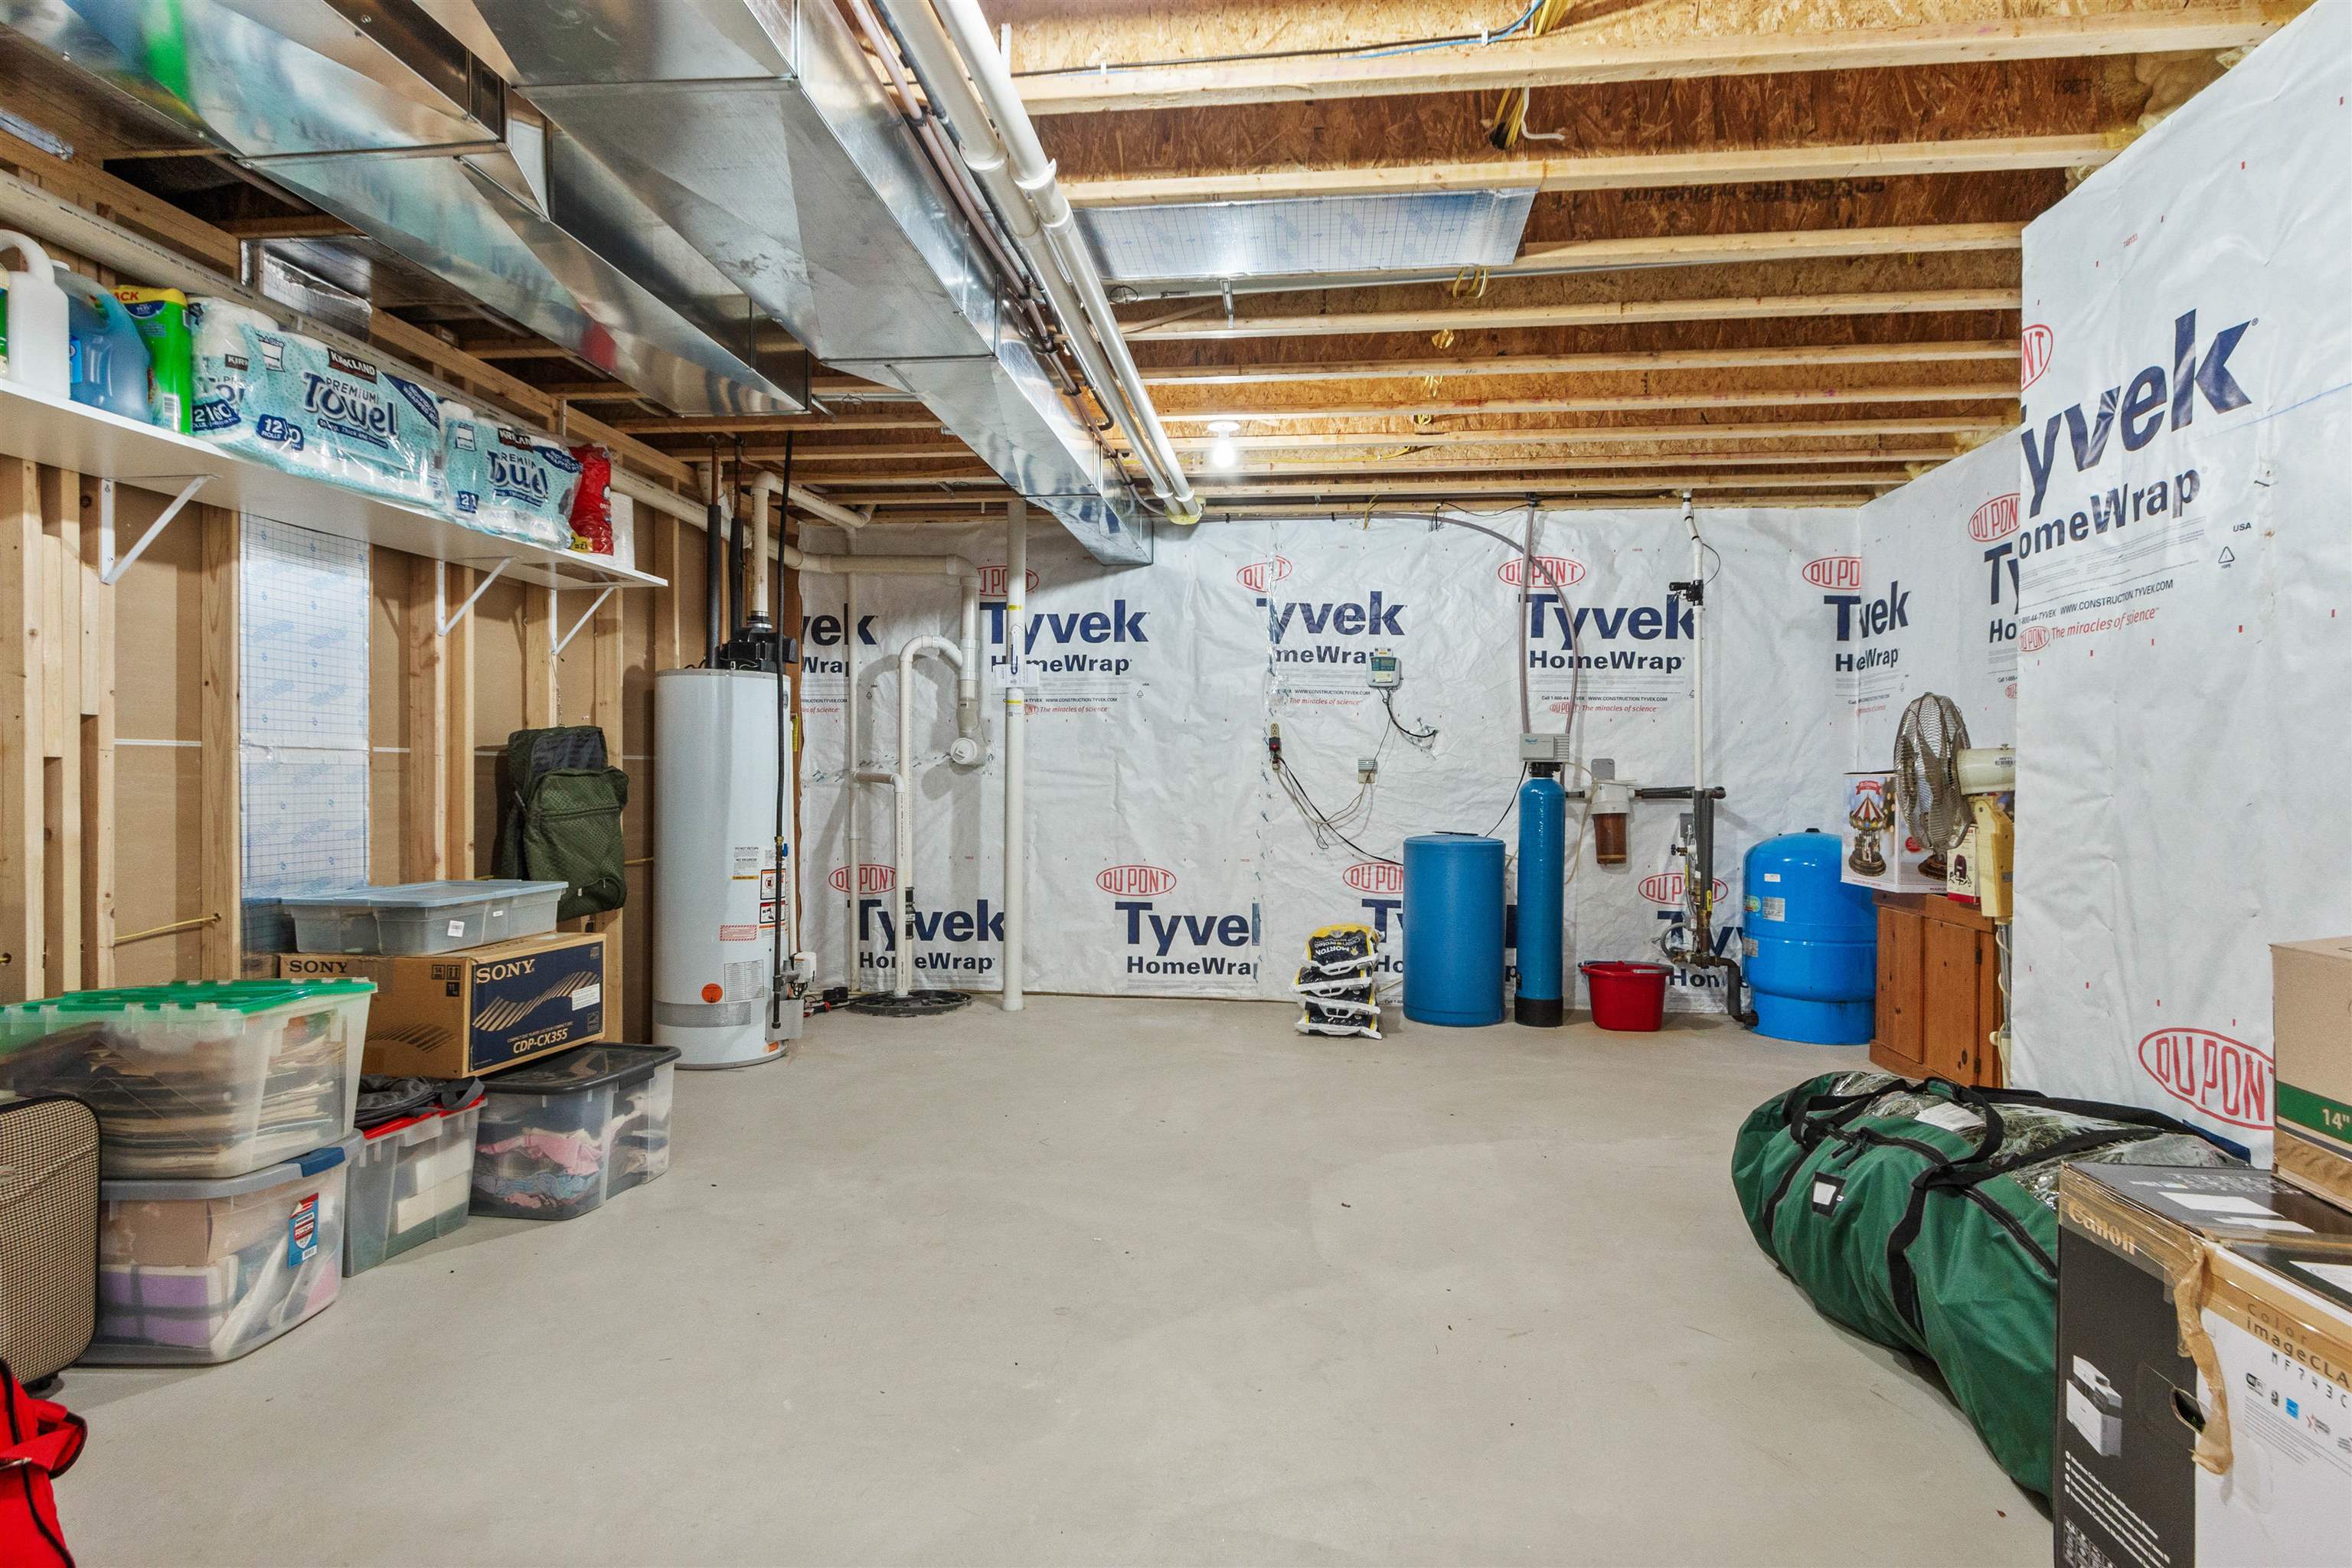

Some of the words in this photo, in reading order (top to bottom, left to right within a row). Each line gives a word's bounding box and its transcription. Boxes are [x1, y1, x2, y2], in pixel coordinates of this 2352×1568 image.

[266, 418, 283, 434] 12
[2021, 309, 2252, 518] yvek
[1971, 498, 2020, 539] DUPON
[2019, 466, 2201, 560] omeWrap
[2233, 522, 2252, 533] USA
[1811, 560, 1860, 586] DUPO
[2052, 626, 2065, 640] The
[2067, 616, 2112, 636] miracles
[2114, 614, 2125, 629] of
[1530, 651, 1682, 673] HomeWrap
[860, 952, 993, 973] HoeWrap
[1315, 946, 1349, 956] MORTON
[289, 960, 348, 973] SONY
[476, 959, 534, 987] SONY
[513, 1028, 568, 1054] CDP-CX355
[2156, 1035, 2273, 1122] DUPON
[2069, 1200, 2135, 1256] Canon
[2248, 1303, 2308, 1345] Color
